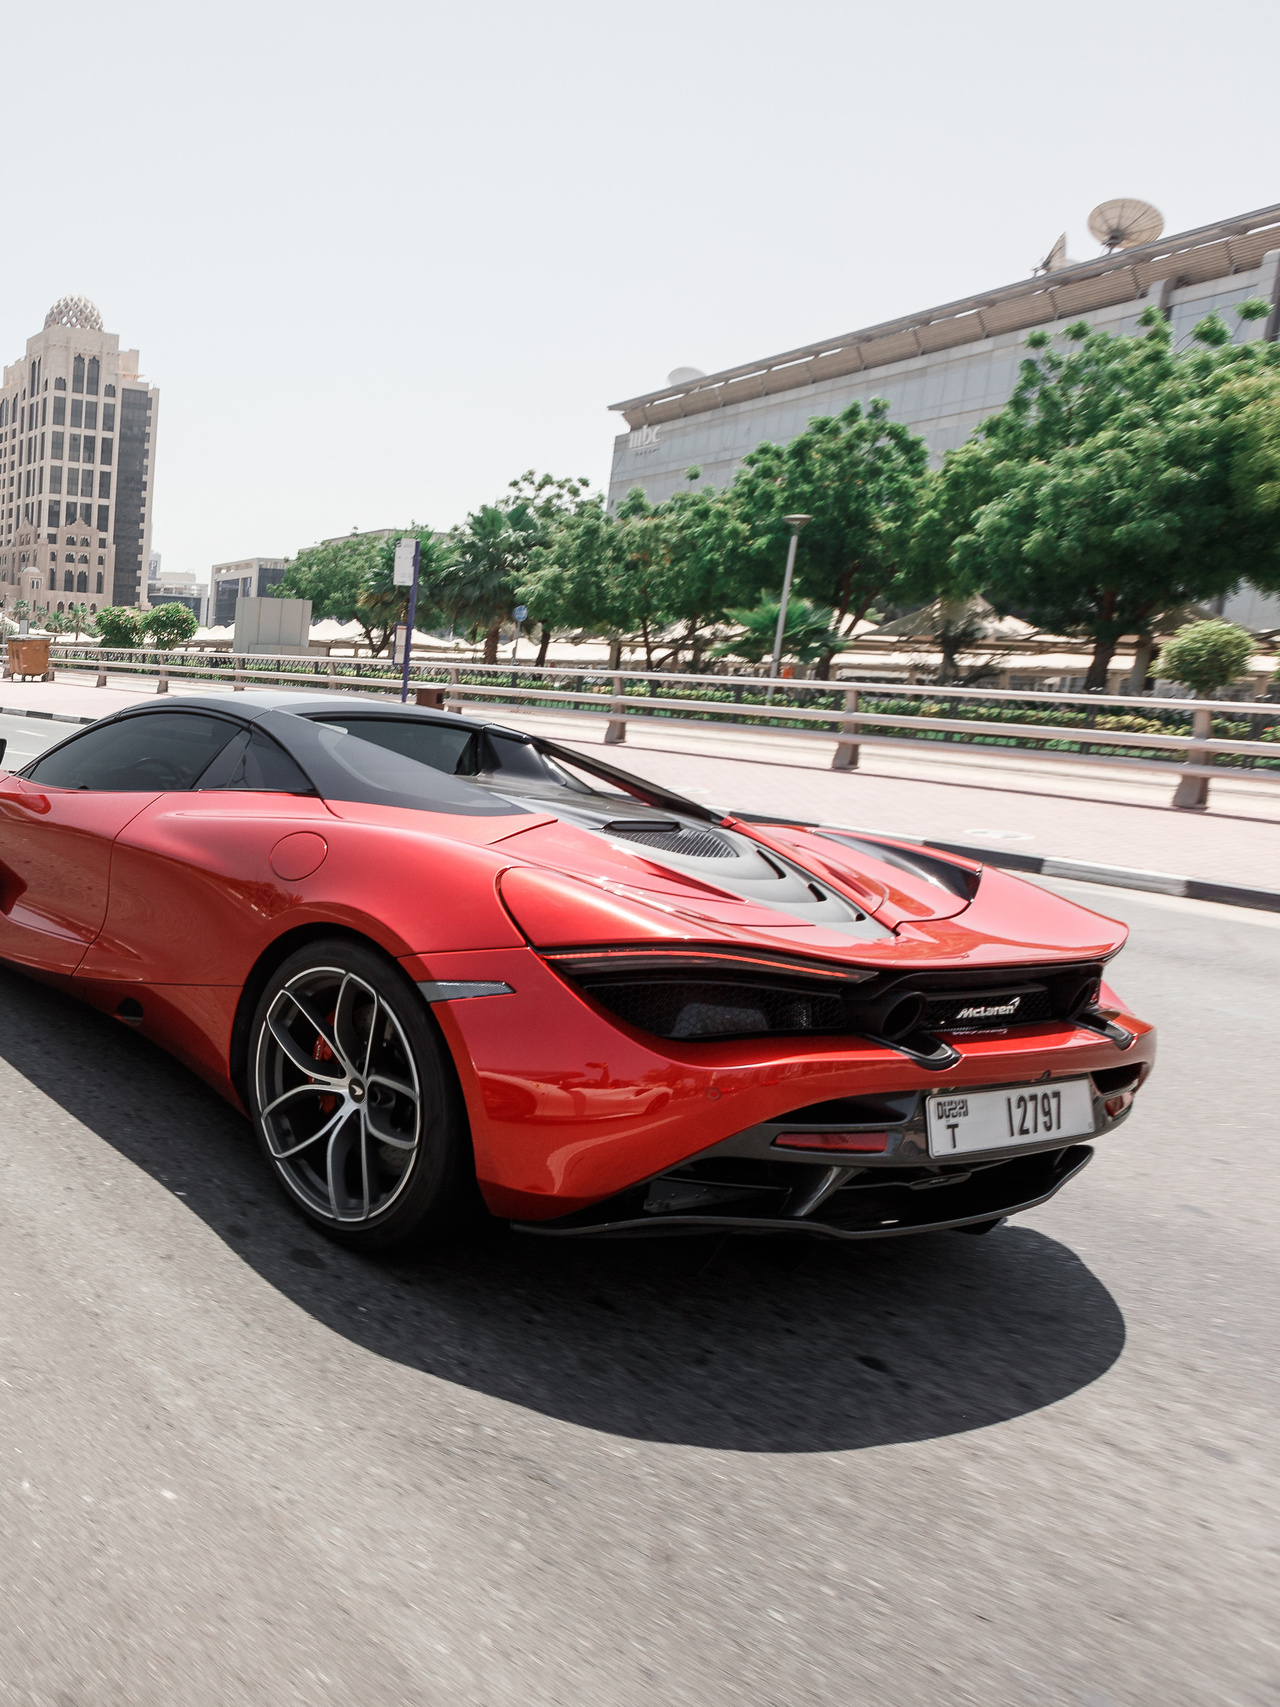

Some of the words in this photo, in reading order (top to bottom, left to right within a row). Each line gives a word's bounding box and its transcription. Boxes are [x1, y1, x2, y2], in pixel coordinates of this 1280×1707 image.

[629, 424, 662, 449] mbc
[955, 1003, 1017, 1019] McLaren
[946, 1123, 959, 1149] T
[1006, 1090, 1062, 1138] 12797
